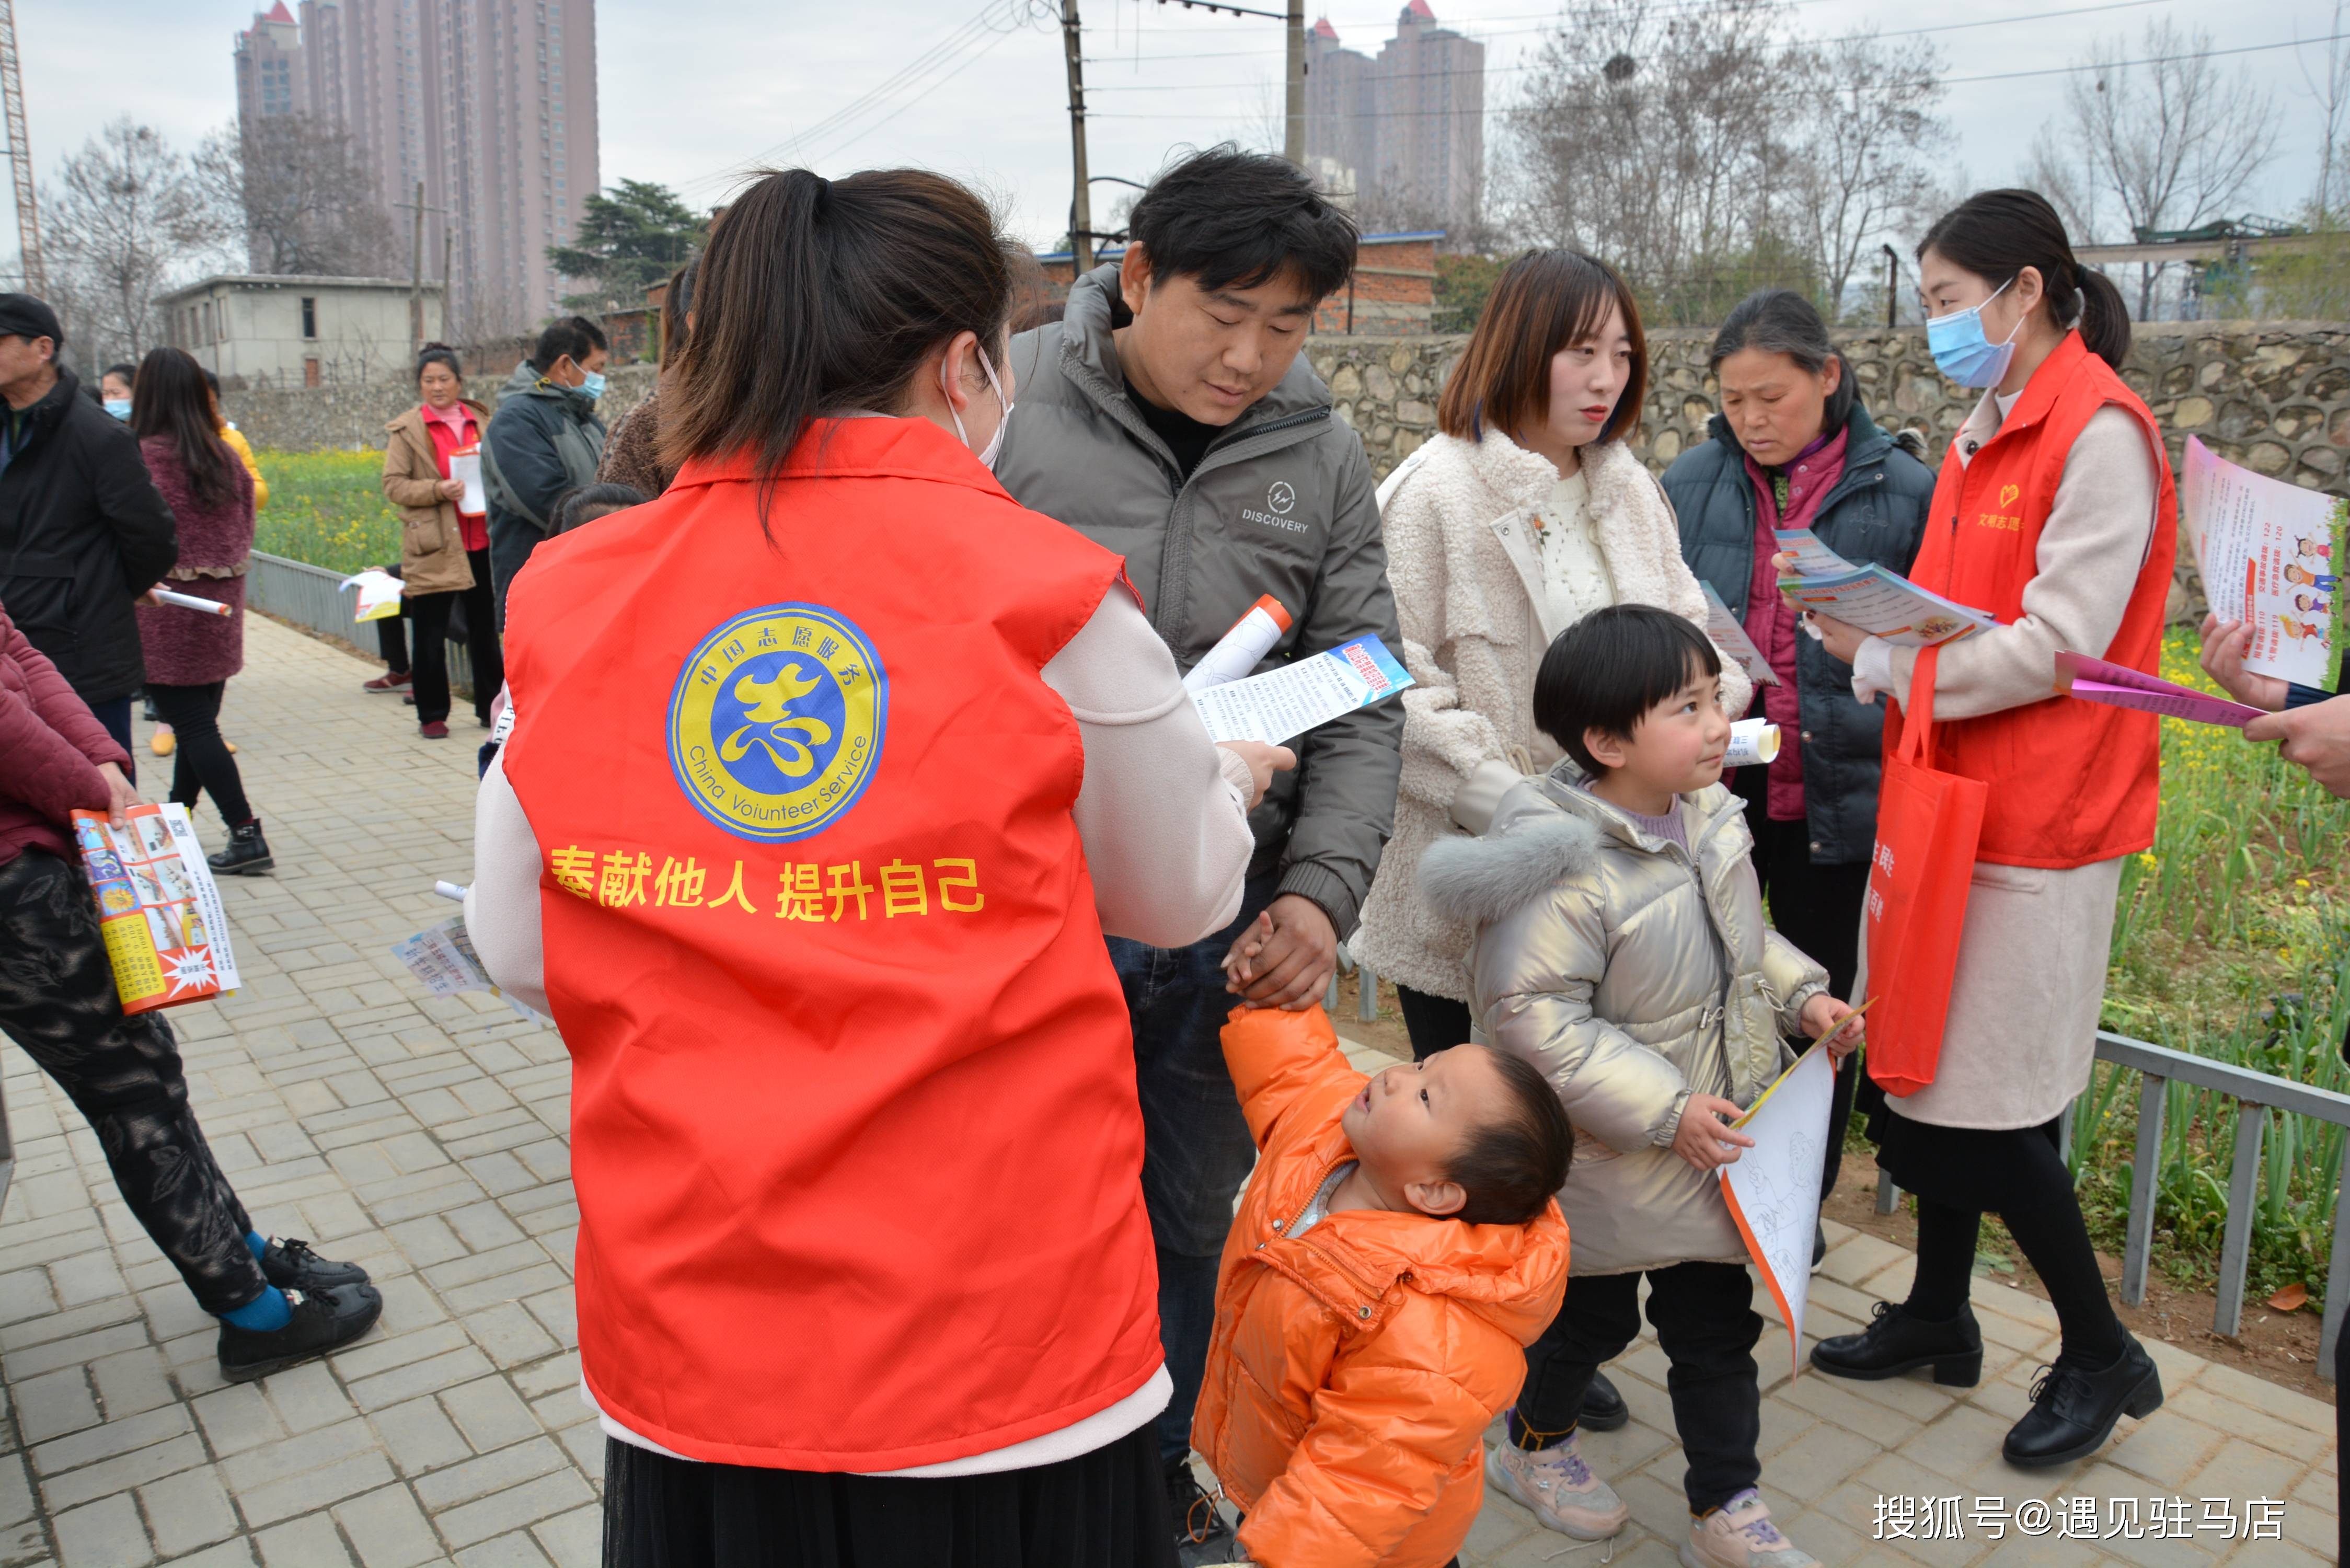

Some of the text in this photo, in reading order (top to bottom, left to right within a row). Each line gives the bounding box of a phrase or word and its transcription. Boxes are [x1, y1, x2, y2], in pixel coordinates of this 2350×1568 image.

[1242, 509, 1308, 534] DISCOVERY
[1977, 512, 2024, 532] 文明志愿
[700, 625, 861, 686] 中国志愿服务
[689, 745, 726, 800] China
[820, 735, 867, 803] Service
[550, 844, 985, 923] 奉献他人 提升自己
